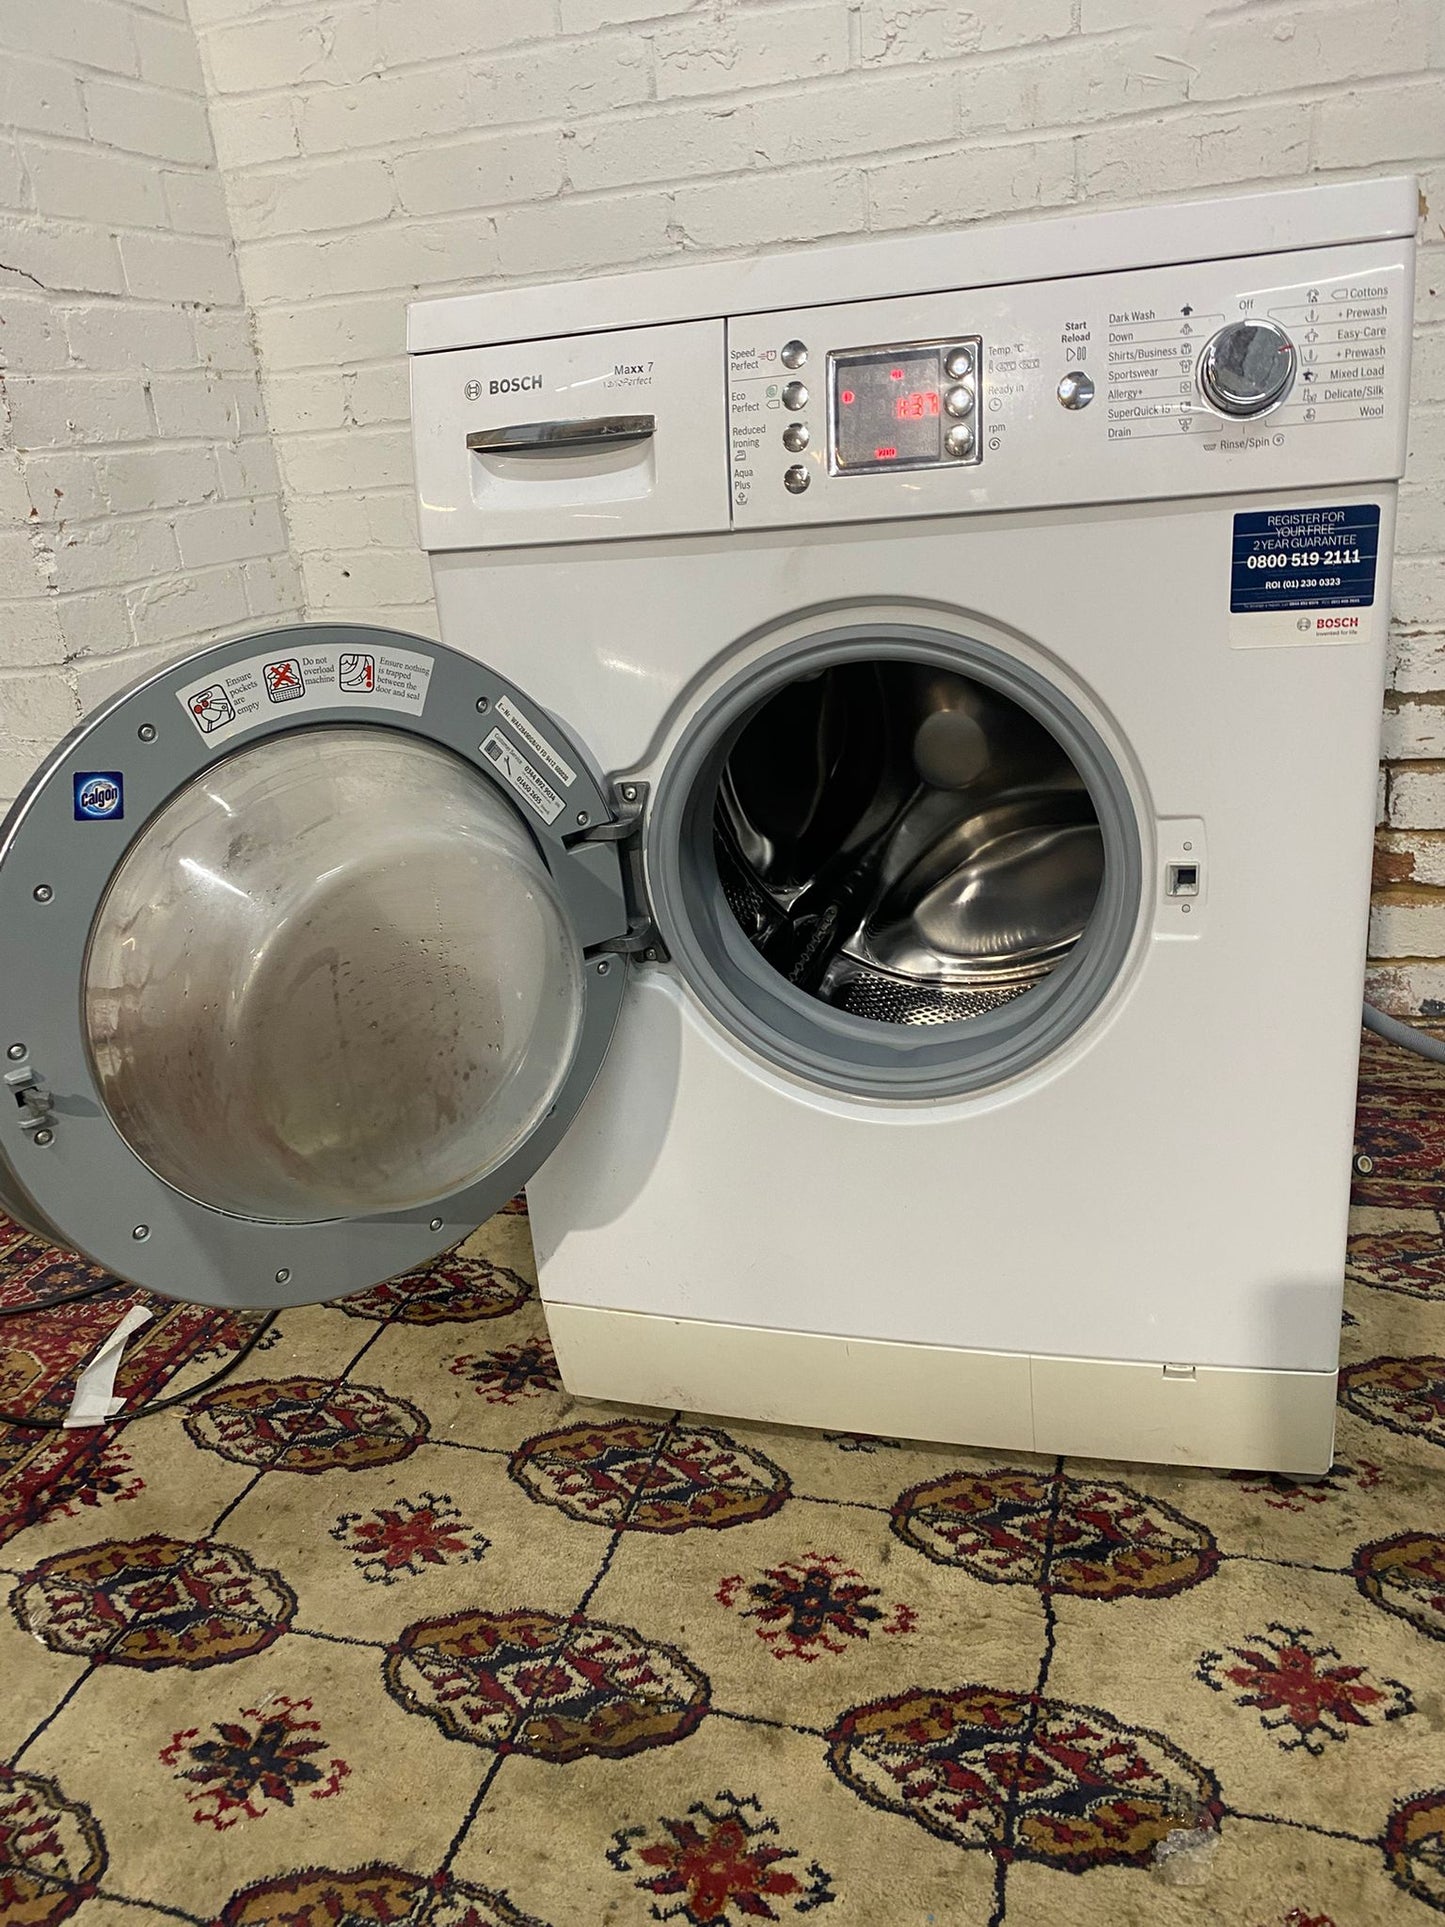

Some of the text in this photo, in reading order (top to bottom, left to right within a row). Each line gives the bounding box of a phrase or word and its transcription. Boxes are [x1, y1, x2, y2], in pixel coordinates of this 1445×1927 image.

[1350, 286, 1388, 298] Cottons
[1239, 299, 1254, 310] Off
[1109, 310, 1156, 324] Dark Wash
[1346, 306, 1388, 319] Prewash
[1066, 322, 1087, 331] Start
[1062, 332, 1090, 343] Reload
[1109, 332, 1134, 342] Down
[730, 348, 756, 360] Speed
[1109, 346, 1178, 362] Shirts/Business
[1345, 346, 1386, 359] Prewash
[614, 361, 654, 376] Maxx 7
[730, 360, 759, 370] Perfect
[1109, 367, 1158, 381] Sportswear
[1330, 366, 1384, 380] Mixed Load
[490, 375, 542, 395] BOSCH
[989, 384, 1024, 395] Ready in
[732, 392, 746, 400] Eco
[1324, 386, 1384, 400] Delicate/Silk
[732, 402, 759, 412] Perfect
[1108, 404, 1158, 419] SuperQuick
[1360, 407, 1384, 416] Wool
[732, 424, 766, 436] Reduced
[988, 424, 1006, 433] rpm
[1108, 426, 1132, 438] Drain
[733, 438, 760, 448] Ironing
[1220, 437, 1270, 450] Rinse/Spin
[734, 468, 753, 480] Aqua
[734, 480, 751, 490] Plus
[1268, 512, 1344, 526] REGISTER FOR
[1276, 524, 1335, 538] YOUR FREE
[1253, 534, 1357, 550] 2 YEAR GUARANTEE
[1247, 549, 1360, 569] 0800 519 2111
[1283, 580, 1299, 589] (01)
[1300, 579, 1316, 587] 230
[1319, 578, 1340, 586] 0323
[1317, 618, 1358, 628] BOSCH
[302, 657, 328, 666] Do not
[380, 657, 430, 676] Ensure nothing
[304, 665, 335, 675] overload
[386, 668, 412, 681] trapped
[225, 671, 252, 688] Ensure
[304, 675, 336, 685] machine
[377, 676, 418, 690] between the
[230, 680, 258, 696] pockets
[376, 686, 420, 700] door and seal
[233, 696, 246, 706] are
[236, 701, 260, 716] empty
